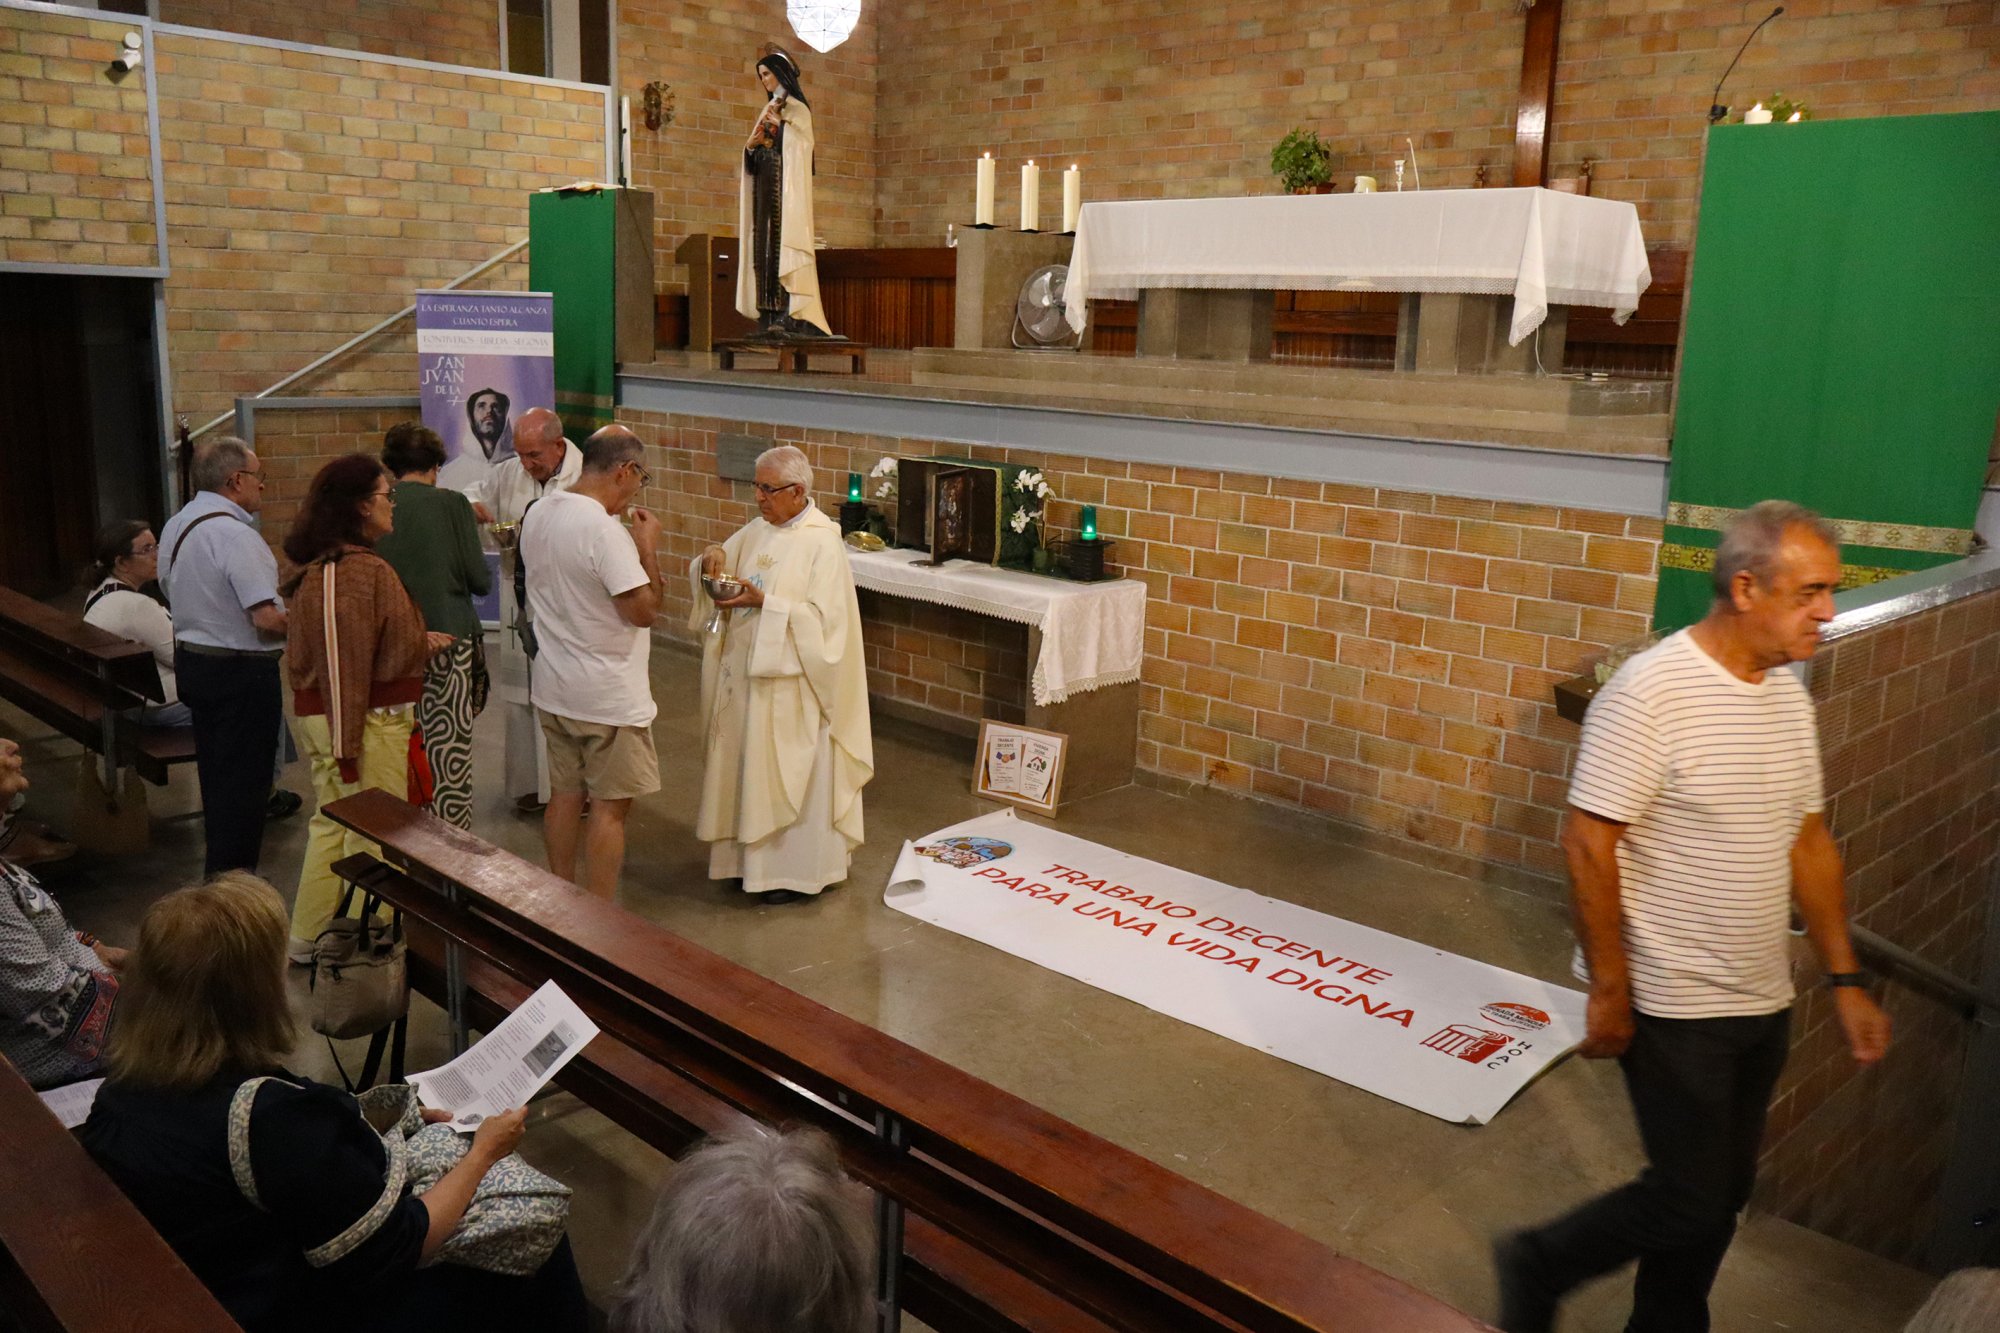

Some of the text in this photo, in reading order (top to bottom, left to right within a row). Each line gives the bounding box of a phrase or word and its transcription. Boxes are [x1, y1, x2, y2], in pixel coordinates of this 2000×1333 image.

[421, 304, 548, 315] LA ESPERANZA TANTO ALCANZA
[453, 317, 519, 327] CUANTO ESPERA
[434, 356, 465, 369] SAN
[435, 385, 461, 395] DE LA
[1042, 863, 1393, 985] TRABAJO DECENTE
[971, 867, 1415, 1028] PARA UNA VIDA DIGNA
